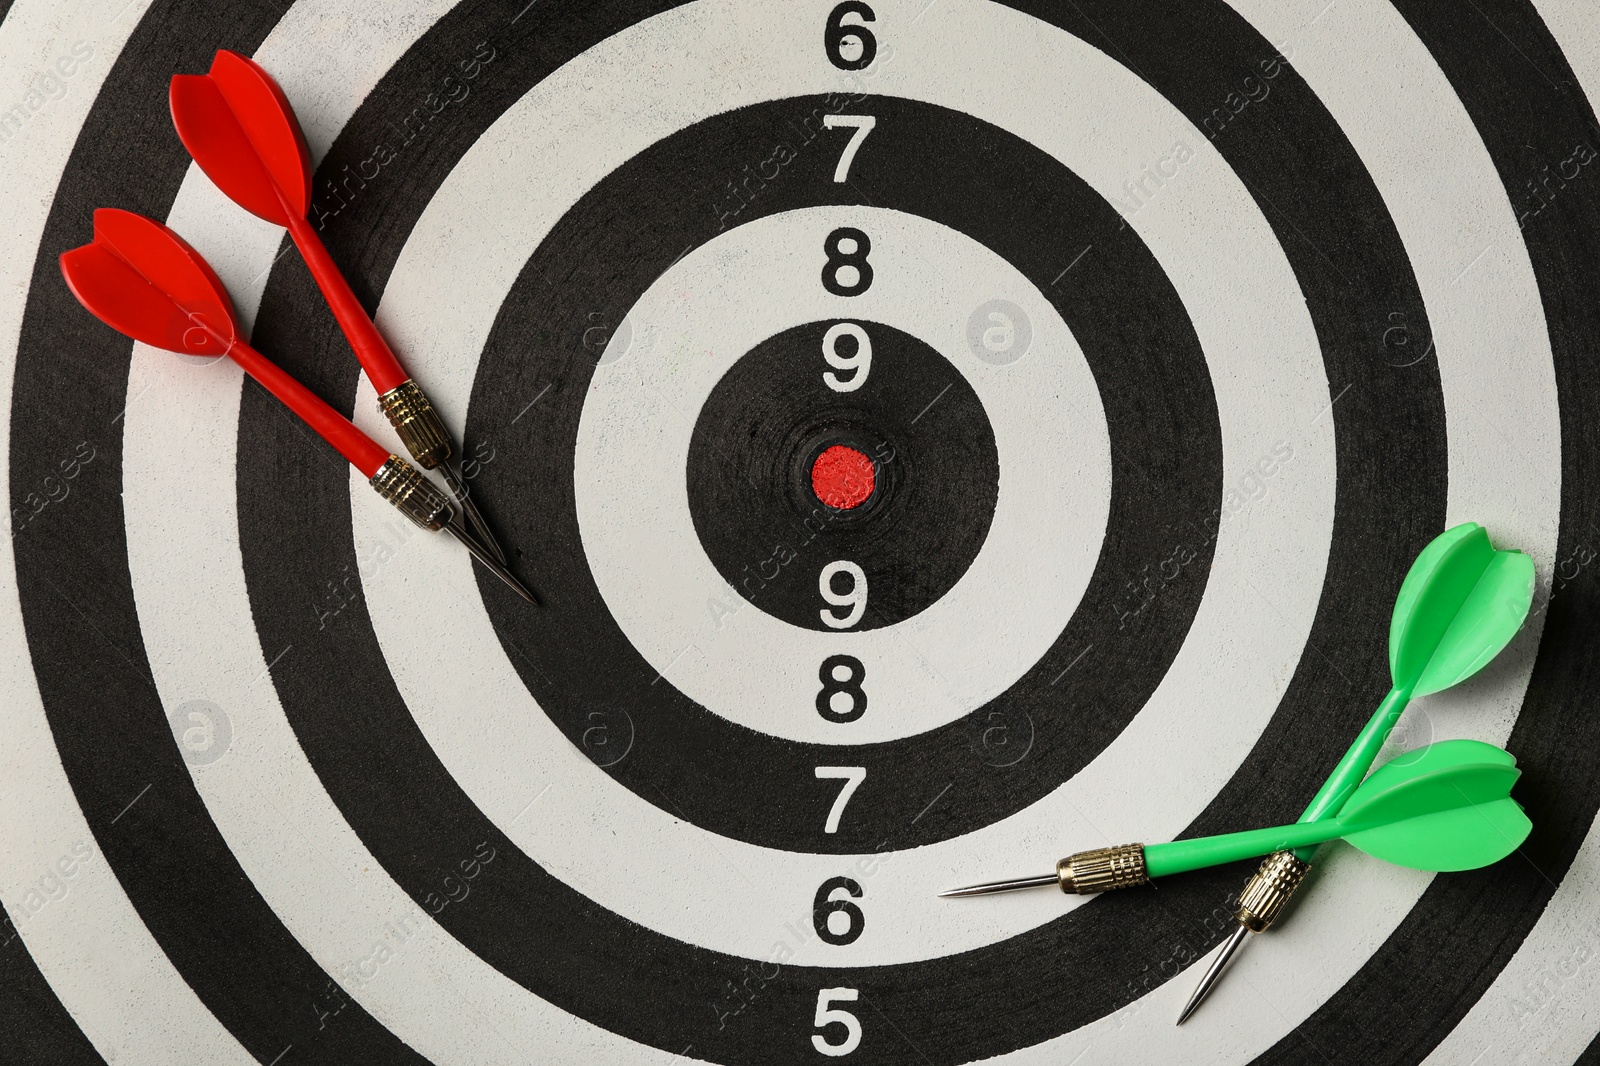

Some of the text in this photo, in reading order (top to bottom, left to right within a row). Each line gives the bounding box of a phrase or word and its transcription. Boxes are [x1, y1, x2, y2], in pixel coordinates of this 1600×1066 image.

[824, 0, 877, 71] 6
[824, 115, 875, 182] 7
[821, 227, 873, 297] 8
[822, 323, 872, 392] 9
[819, 561, 868, 629] 9
[816, 654, 867, 723] 8
[815, 766, 866, 833] 7
[813, 876, 865, 946] 6
[811, 987, 862, 1056] 5
